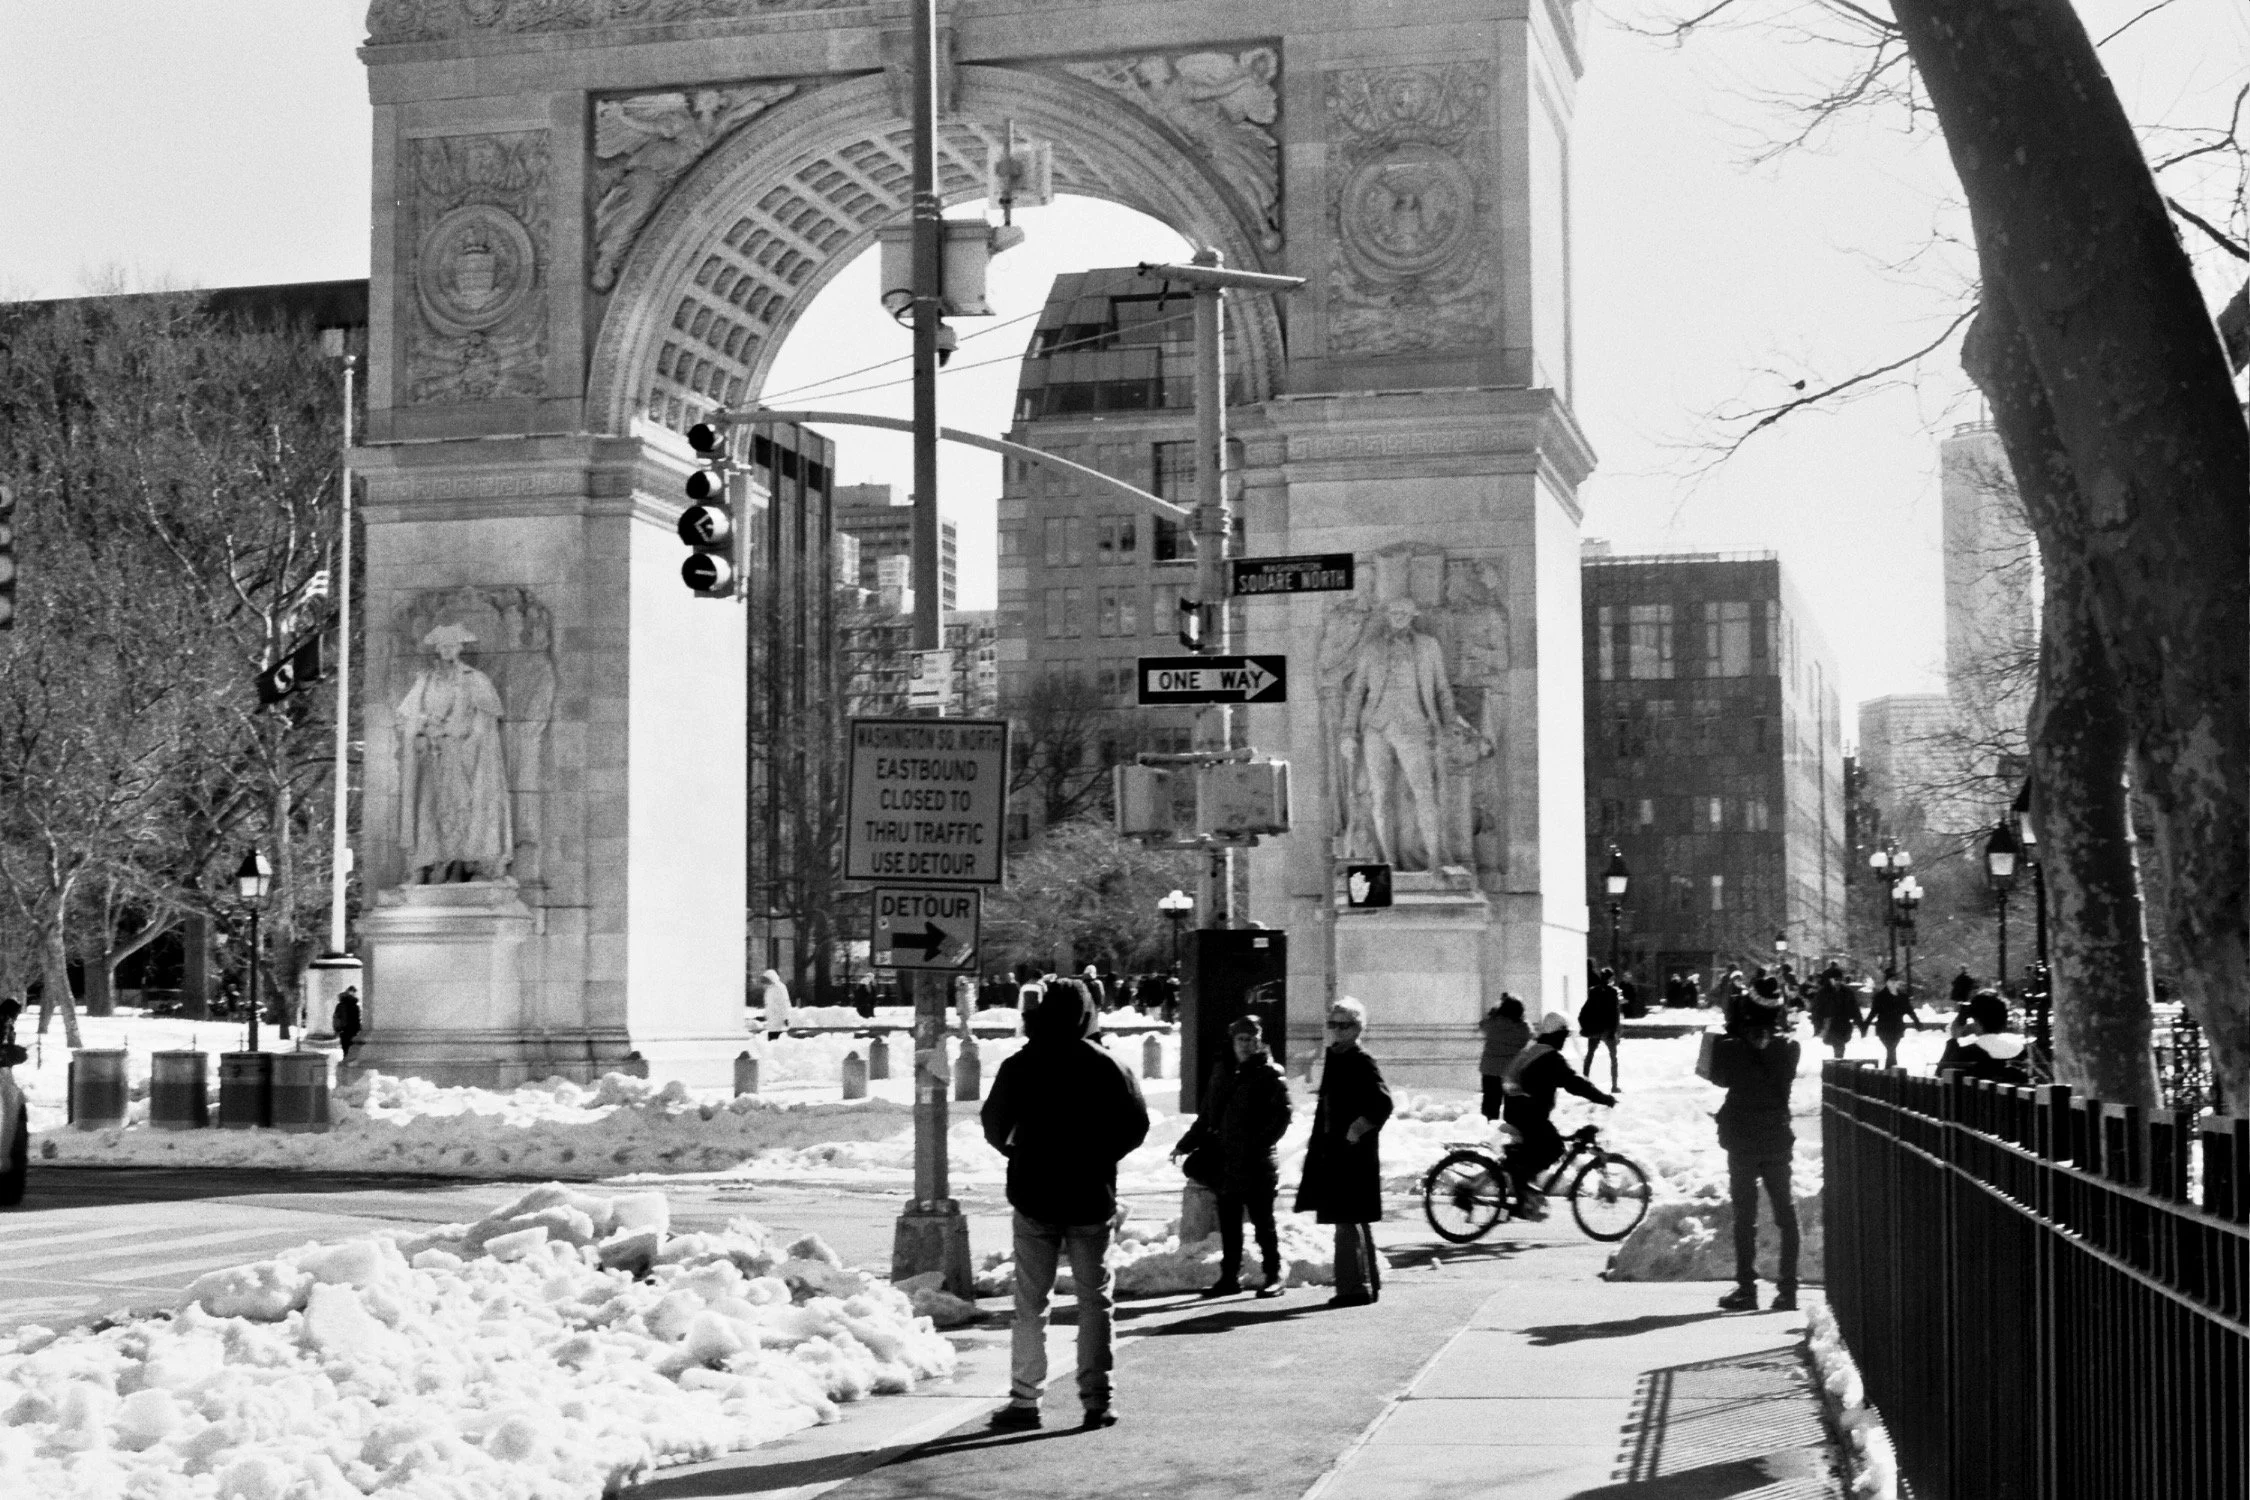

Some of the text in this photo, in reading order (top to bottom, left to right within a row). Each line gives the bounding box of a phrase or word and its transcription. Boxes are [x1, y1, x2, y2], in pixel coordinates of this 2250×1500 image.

[1238, 570, 1346, 592] SQUARE NORTH
[1158, 670, 1264, 691] ONE WAY
[857, 726, 935, 750] WASHINGTON
[957, 729, 1002, 751] NORTH
[877, 758, 977, 781] EASTBOUND
[880, 788, 972, 811] CLOSED TO
[866, 820, 984, 845] THRU TRAFFIC
[872, 852, 976, 875] USE DETOUR
[881, 895, 971, 919] DETOUR
